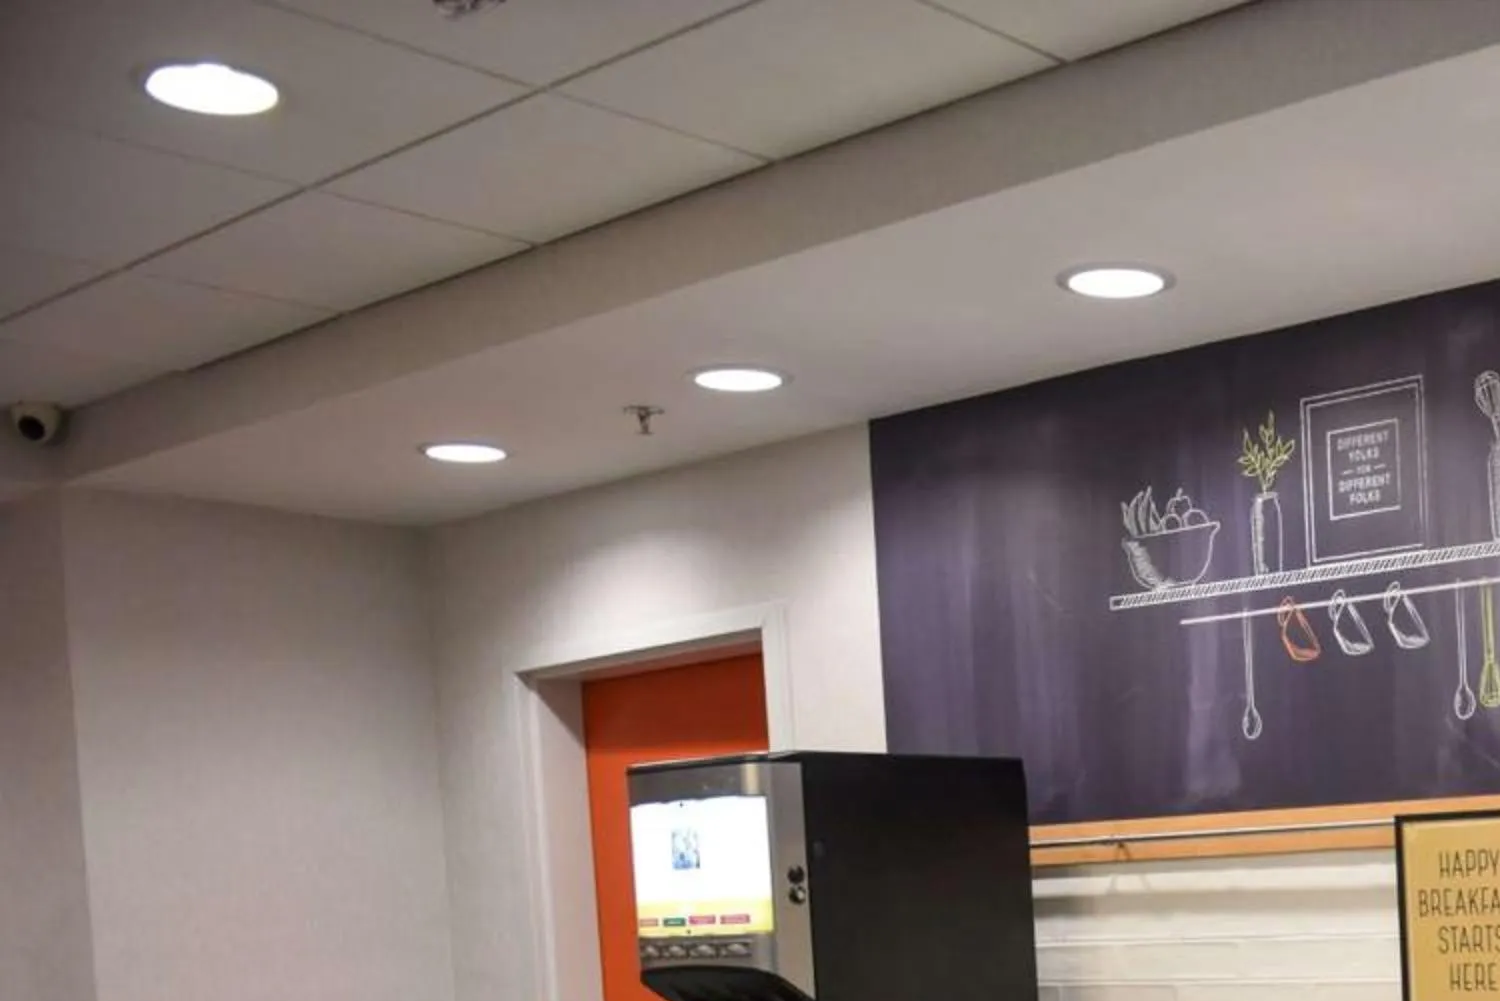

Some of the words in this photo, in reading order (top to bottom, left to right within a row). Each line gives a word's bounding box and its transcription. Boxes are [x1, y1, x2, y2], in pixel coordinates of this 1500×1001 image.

[1337, 429, 1389, 451] DIFFERENT
[1338, 472, 1391, 493] DIFFERENT
[1349, 489, 1381, 505] FOLKS
[1438, 848, 1500, 879] HAPPY
[1448, 963, 1500, 992] HERE
